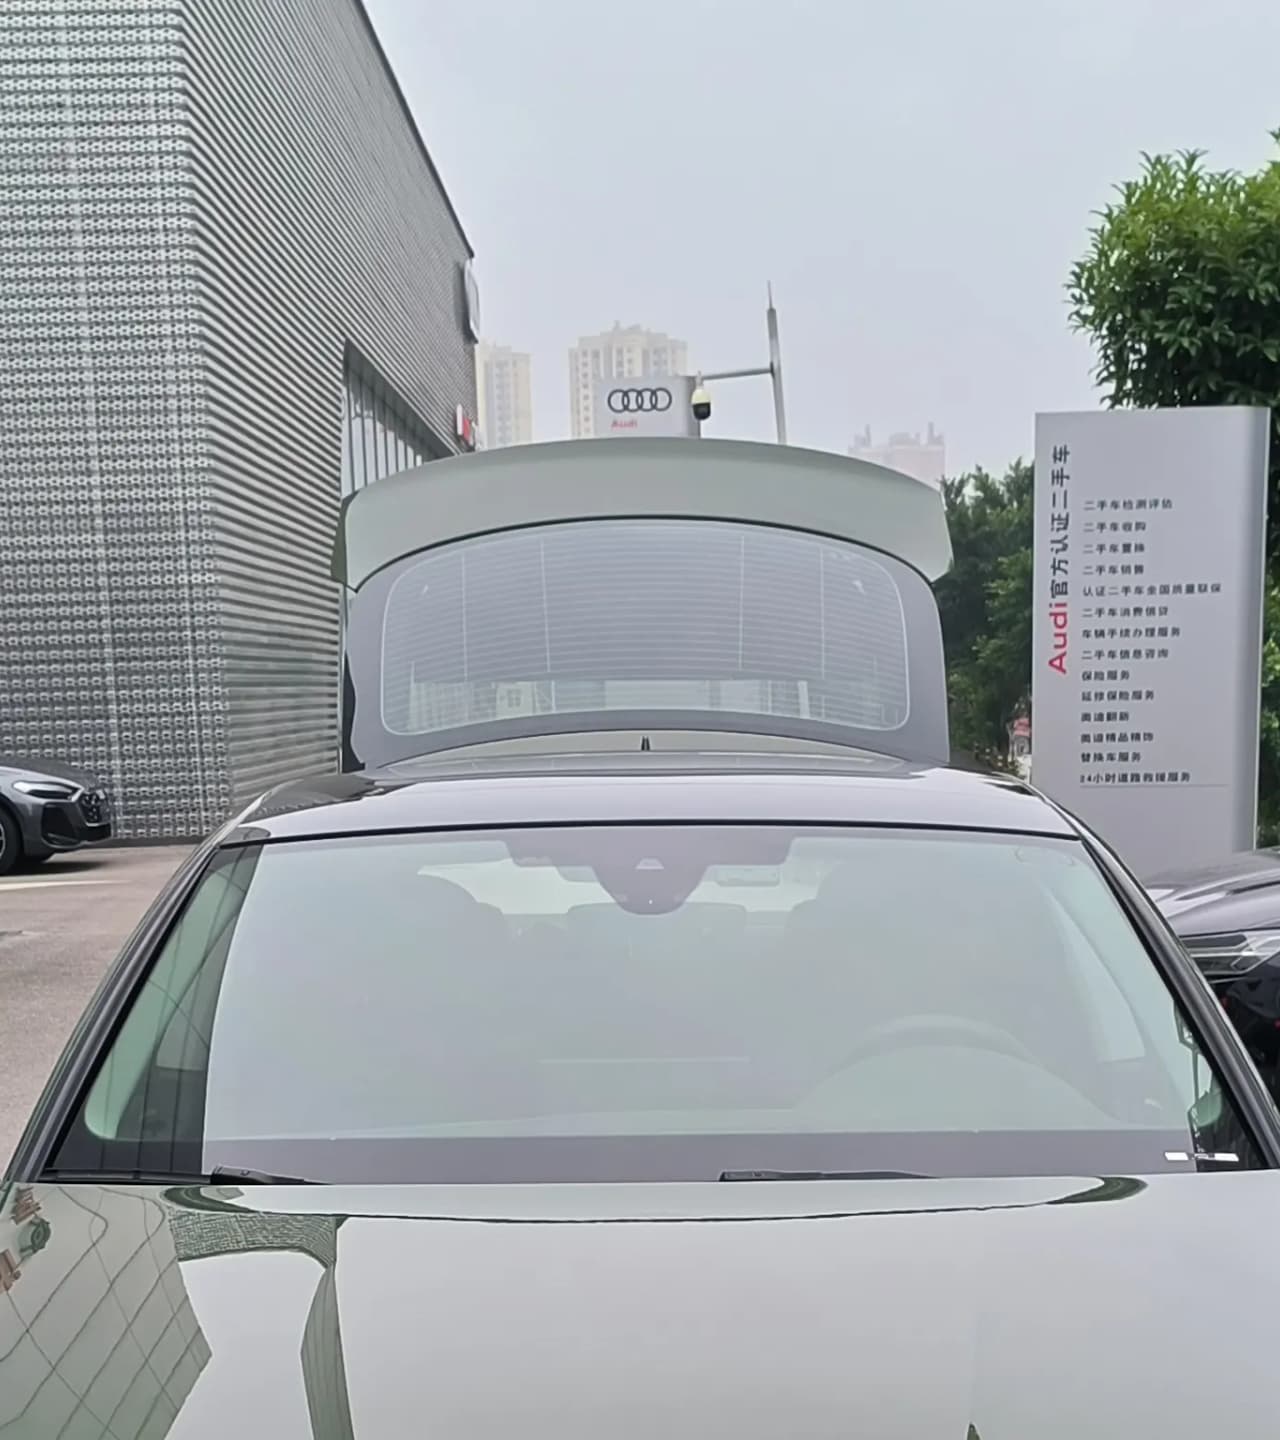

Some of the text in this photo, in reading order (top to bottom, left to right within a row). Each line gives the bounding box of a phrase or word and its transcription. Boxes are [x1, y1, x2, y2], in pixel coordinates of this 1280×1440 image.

[1048, 443, 1070, 675] Audi 官方认证二手车
